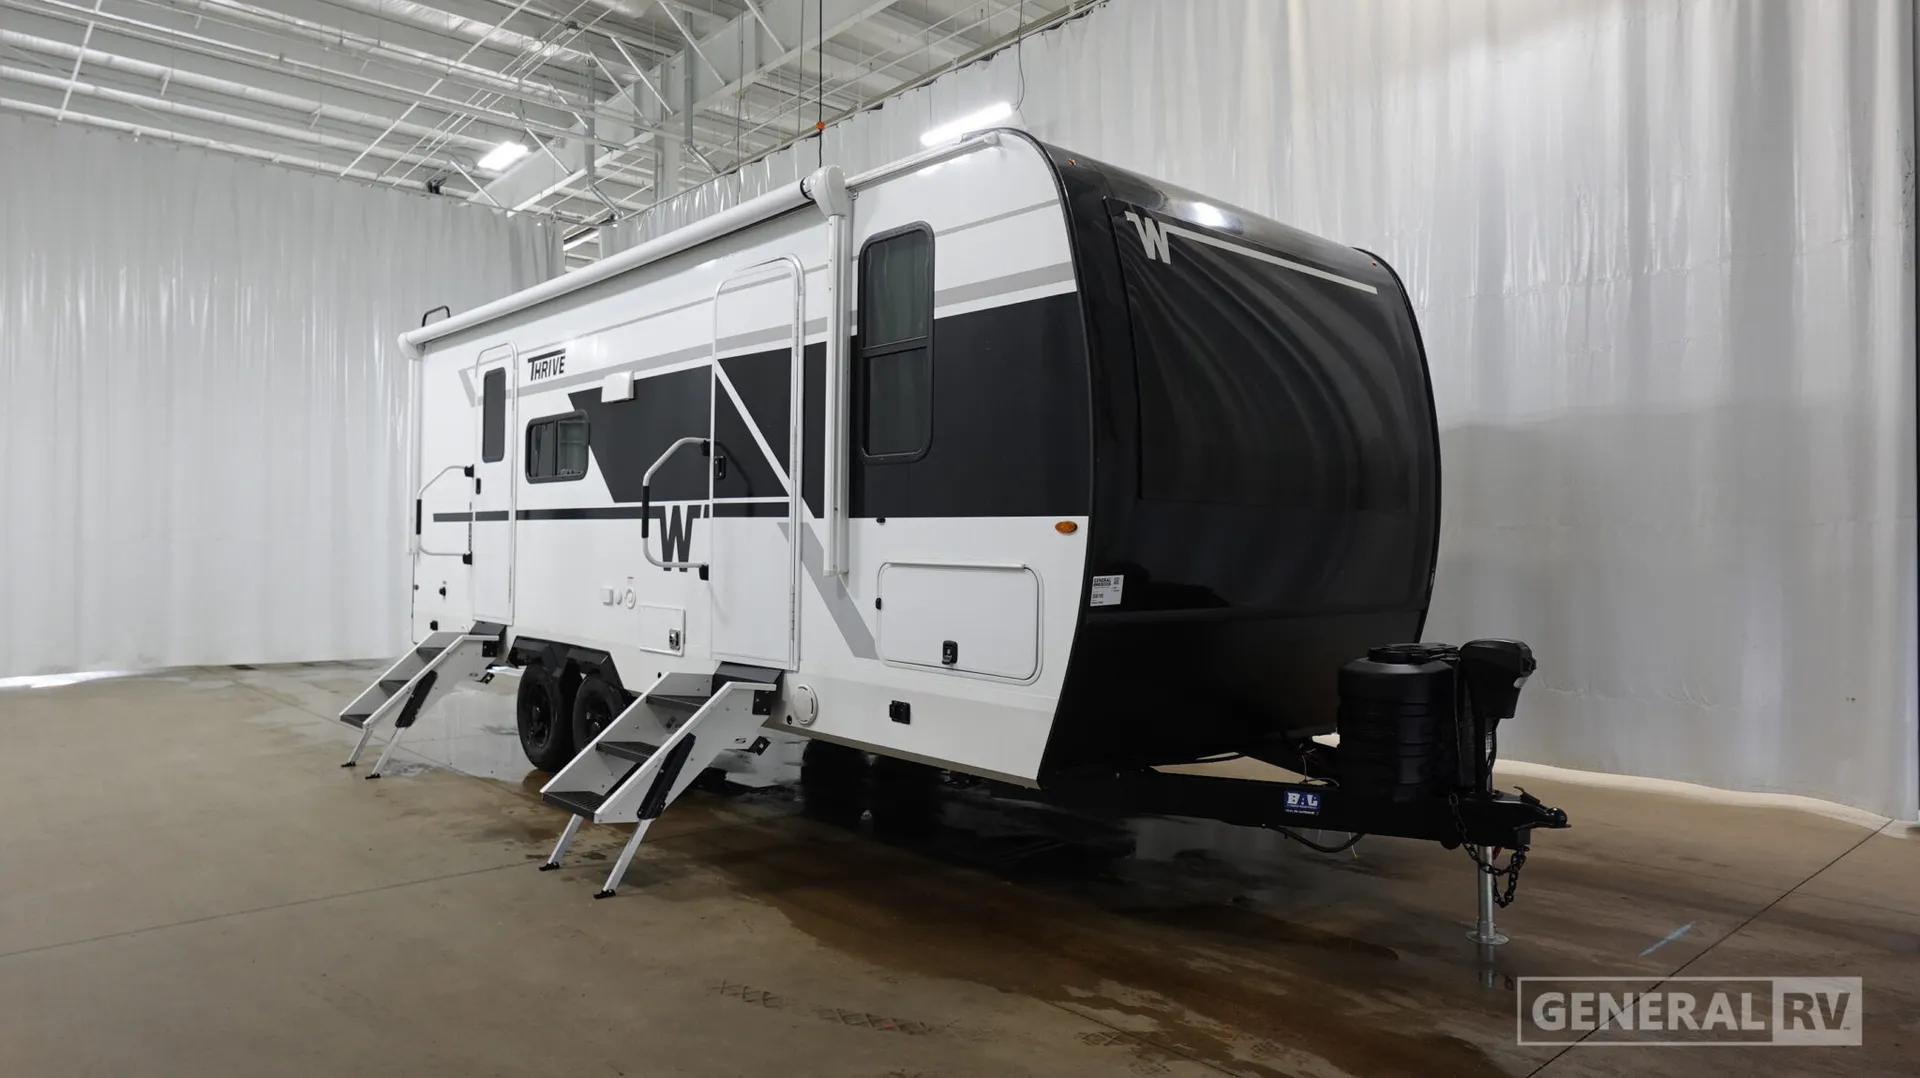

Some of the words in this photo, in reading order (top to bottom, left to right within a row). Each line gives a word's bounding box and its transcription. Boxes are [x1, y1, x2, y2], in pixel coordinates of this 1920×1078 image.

[1124, 211, 1171, 264] W
[528, 348, 566, 381] THRIVE
[658, 505, 702, 572] W
